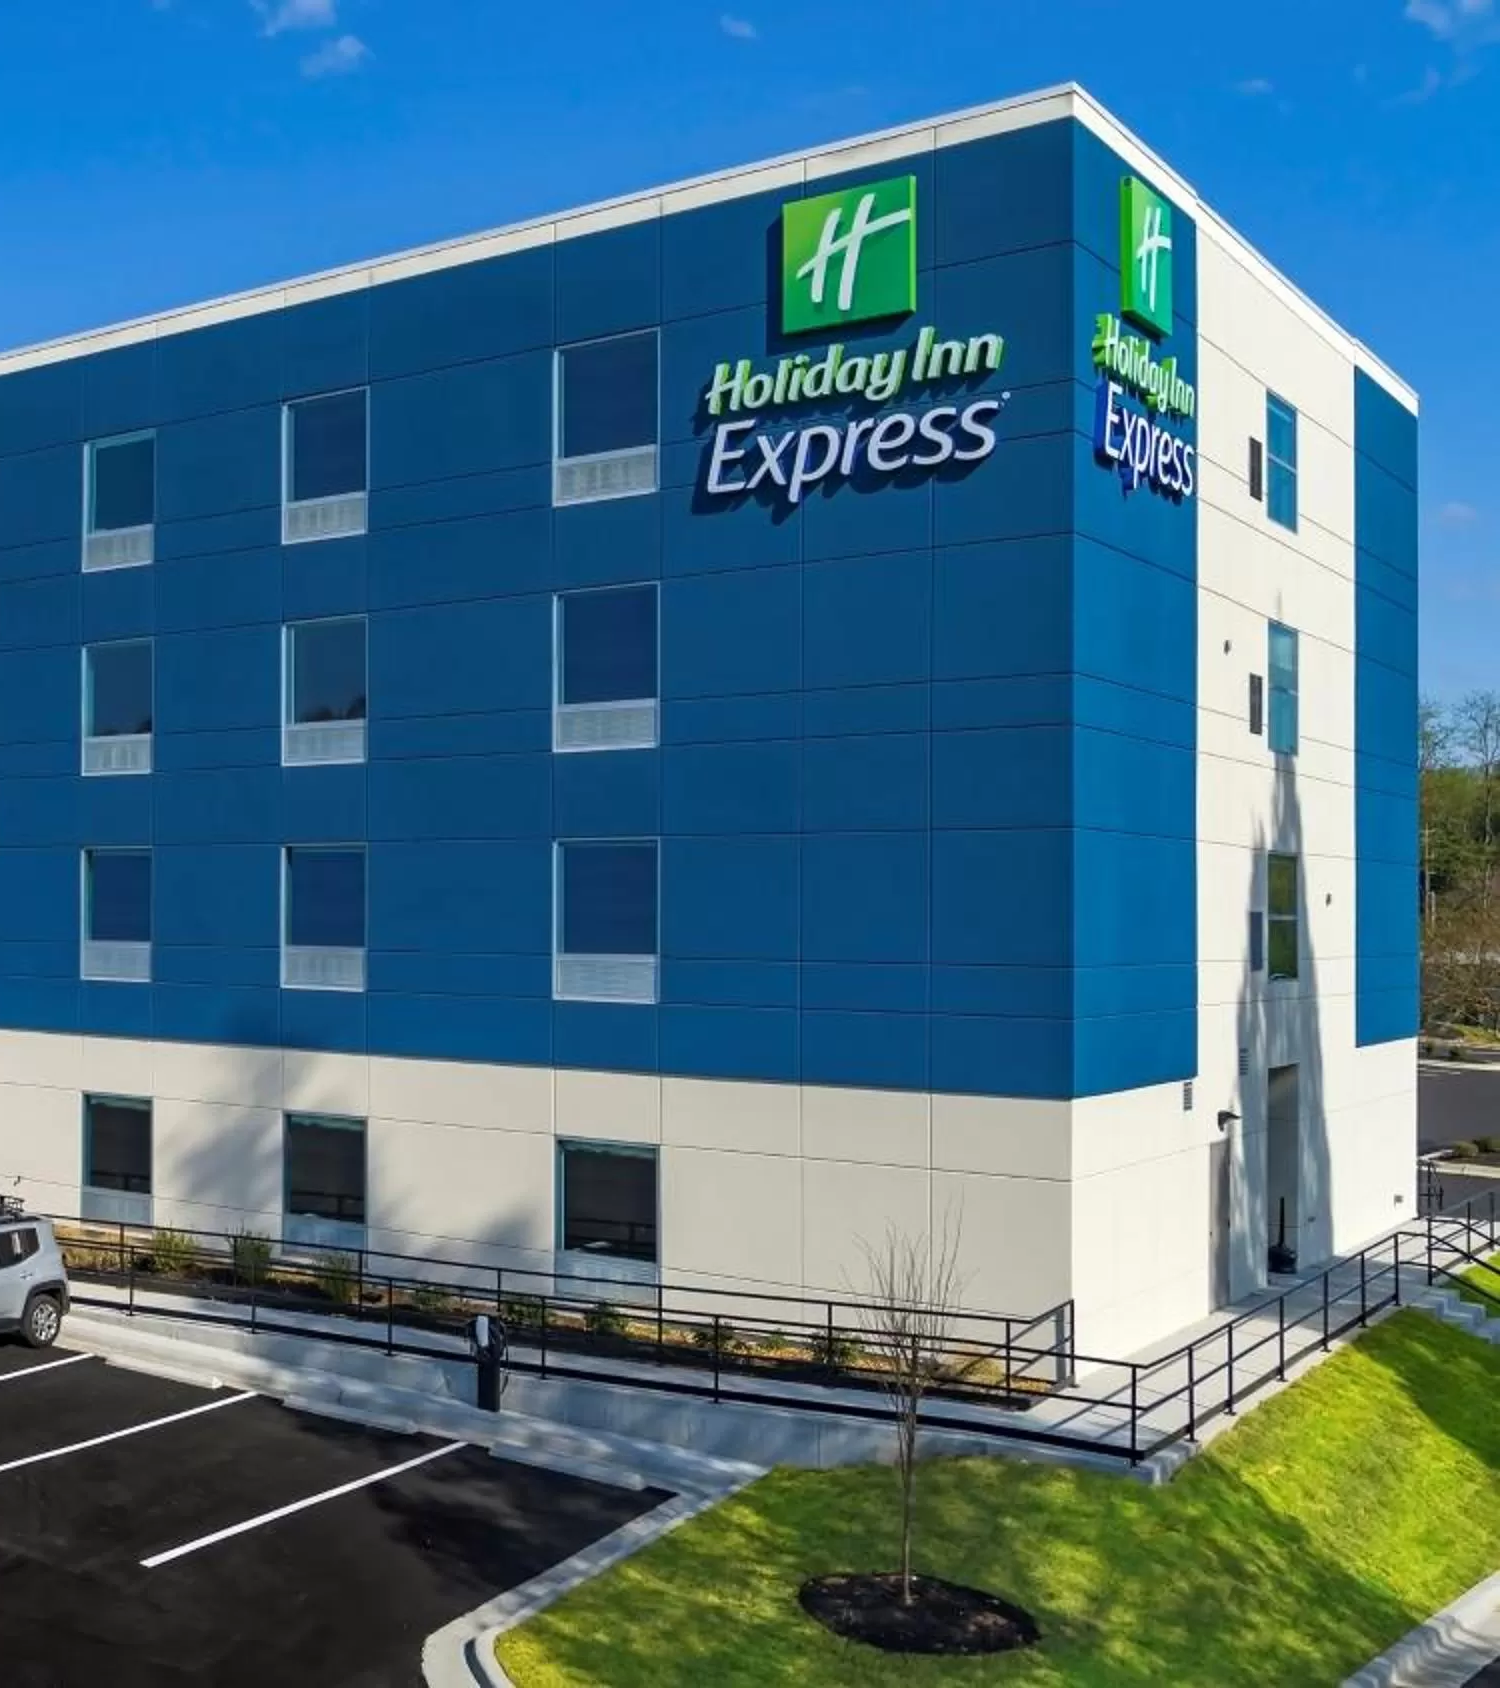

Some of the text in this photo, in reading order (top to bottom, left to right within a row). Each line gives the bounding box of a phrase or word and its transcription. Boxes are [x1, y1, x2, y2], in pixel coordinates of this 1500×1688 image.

[796, 193, 911, 311] H
[705, 325, 1005, 415] Holiday Inn
[1100, 313, 1195, 418] Holiday Inn
[707, 400, 999, 503] Express
[1104, 380, 1195, 497] Express
